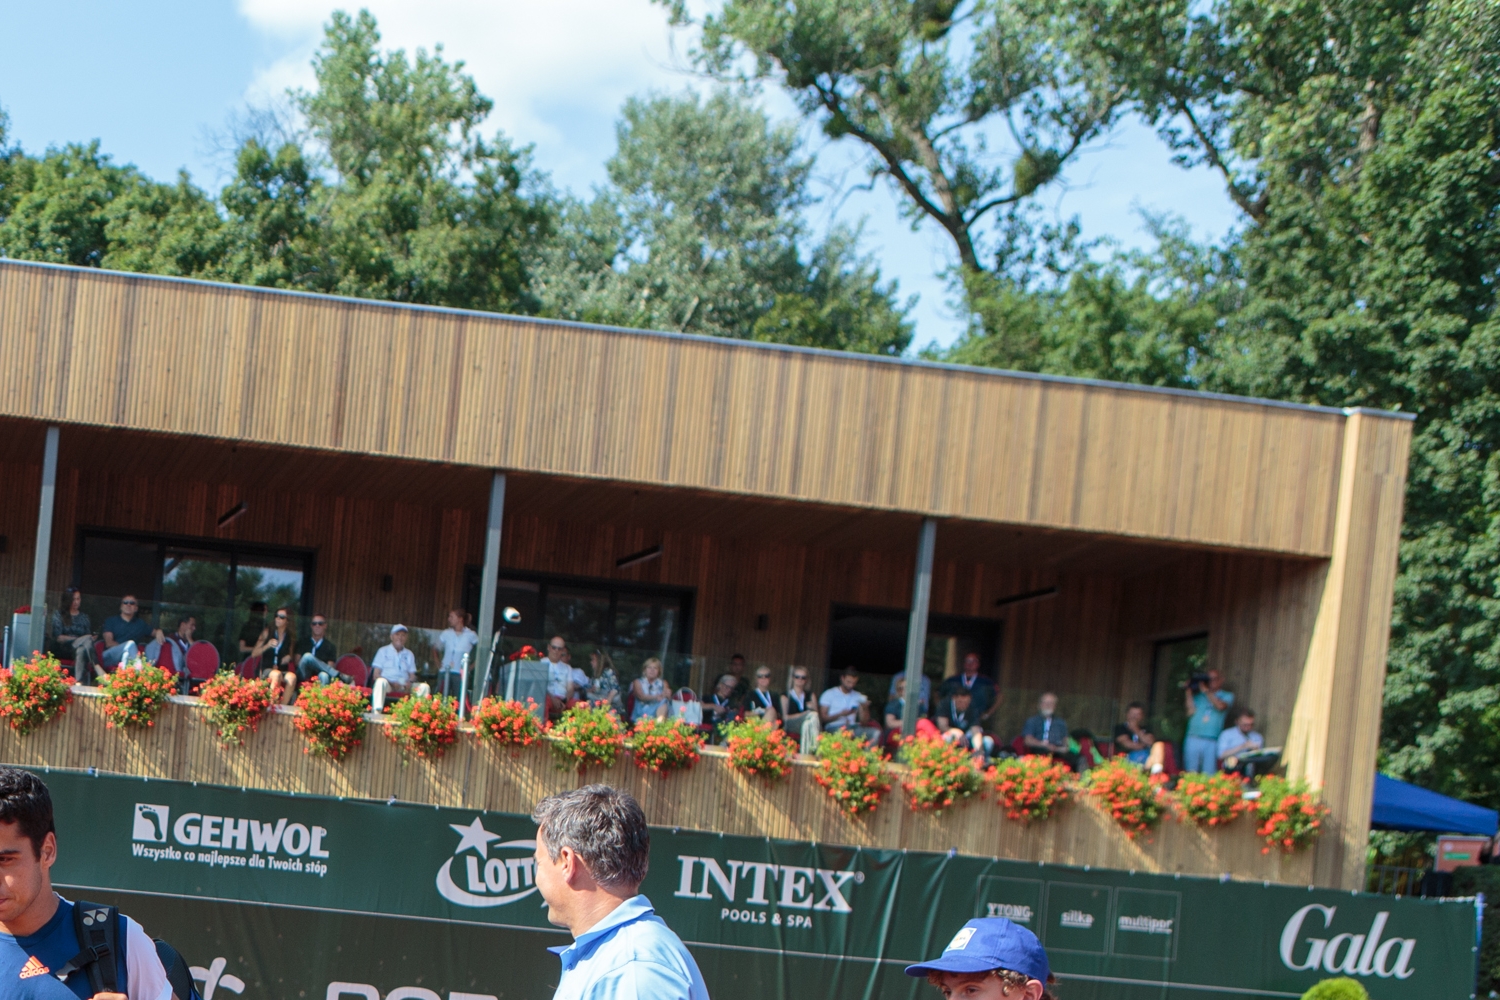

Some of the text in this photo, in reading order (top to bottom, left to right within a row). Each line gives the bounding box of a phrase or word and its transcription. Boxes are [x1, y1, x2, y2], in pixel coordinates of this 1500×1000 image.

[132, 843, 328, 878] Wszystko co najlepsze dla Twoich stóp
[466, 855, 537, 893] LOTT
[721, 908, 813, 929] POOLS & SPA
[1060, 909, 1094, 924] silka
[1118, 914, 1174, 934] multipor
[1279, 903, 1416, 979] Gala
